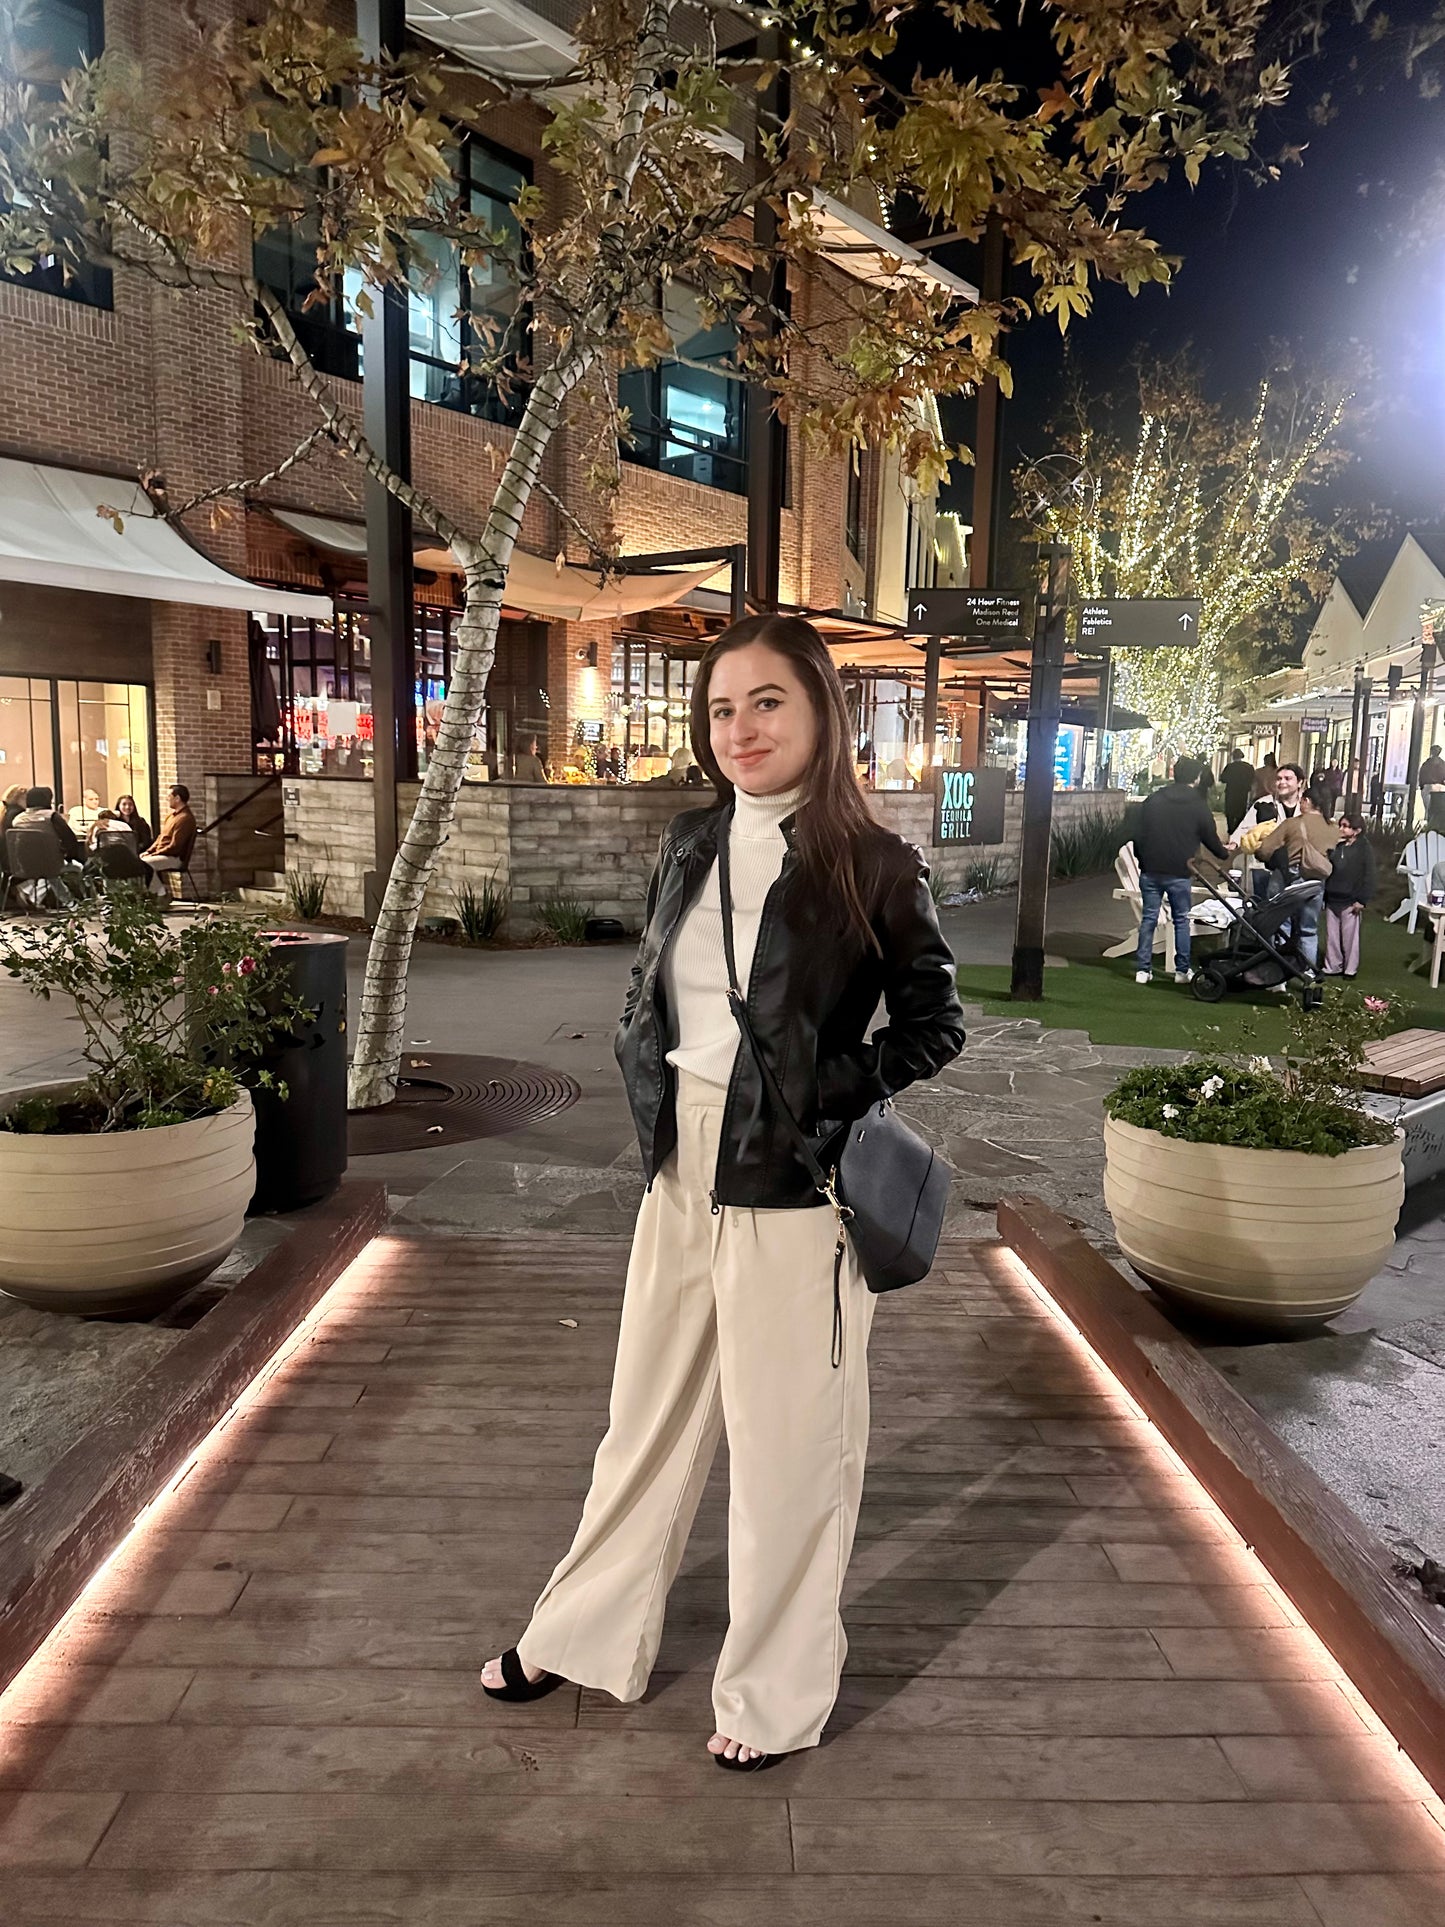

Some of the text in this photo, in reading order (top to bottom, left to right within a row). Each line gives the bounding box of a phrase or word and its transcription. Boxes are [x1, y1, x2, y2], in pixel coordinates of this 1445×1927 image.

[966, 597, 1020, 606] 24 Hour Fitness
[972, 608, 1019, 616] Madison Reed
[1082, 606, 1109, 615] Athleta
[976, 618, 1019, 626] One Medical
[1082, 617, 1112, 625] Fabletics
[1081, 627, 1096, 636] REI
[1303, 718, 1327, 726] Planet
[1302, 725, 1328, 733] Beauty
[941, 771, 975, 810] XOC
[941, 810, 972, 822] TEQUILA
[941, 822, 971, 839] GRILL
